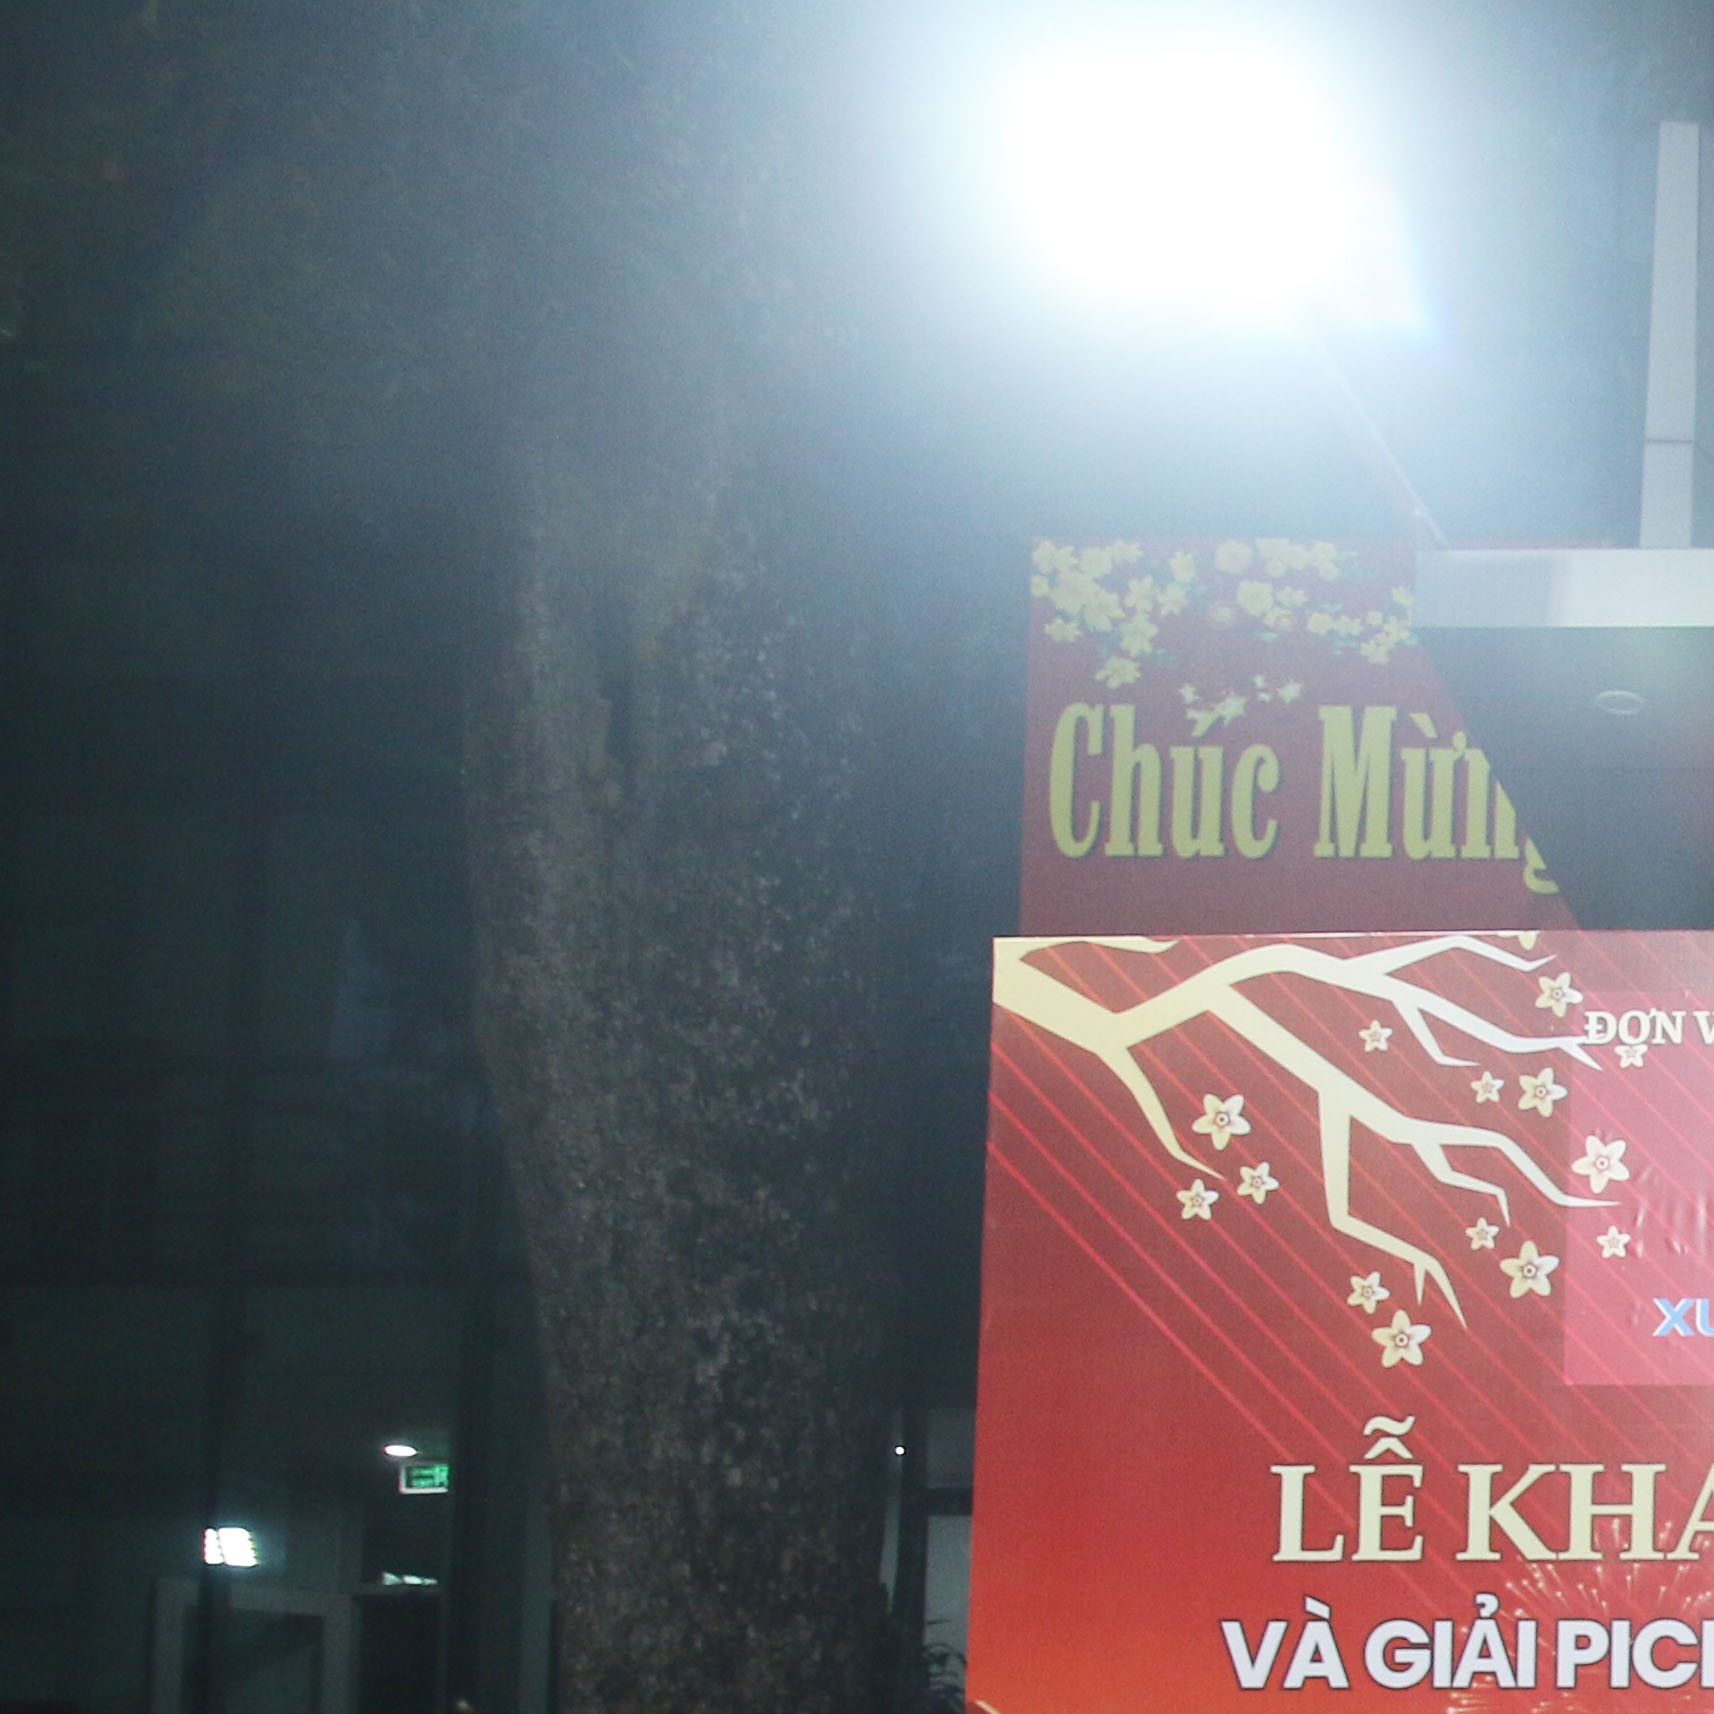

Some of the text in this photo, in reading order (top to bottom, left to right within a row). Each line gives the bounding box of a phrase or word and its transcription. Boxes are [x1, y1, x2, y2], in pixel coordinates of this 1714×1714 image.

[1049, 700, 1279, 862] Chúc
[1583, 1006, 1684, 1046] ĐƠN
[1270, 1415, 1425, 1564] LỄ
[1219, 1596, 1350, 1691] VÀ
[1362, 1592, 1538, 1691] GIẢI
